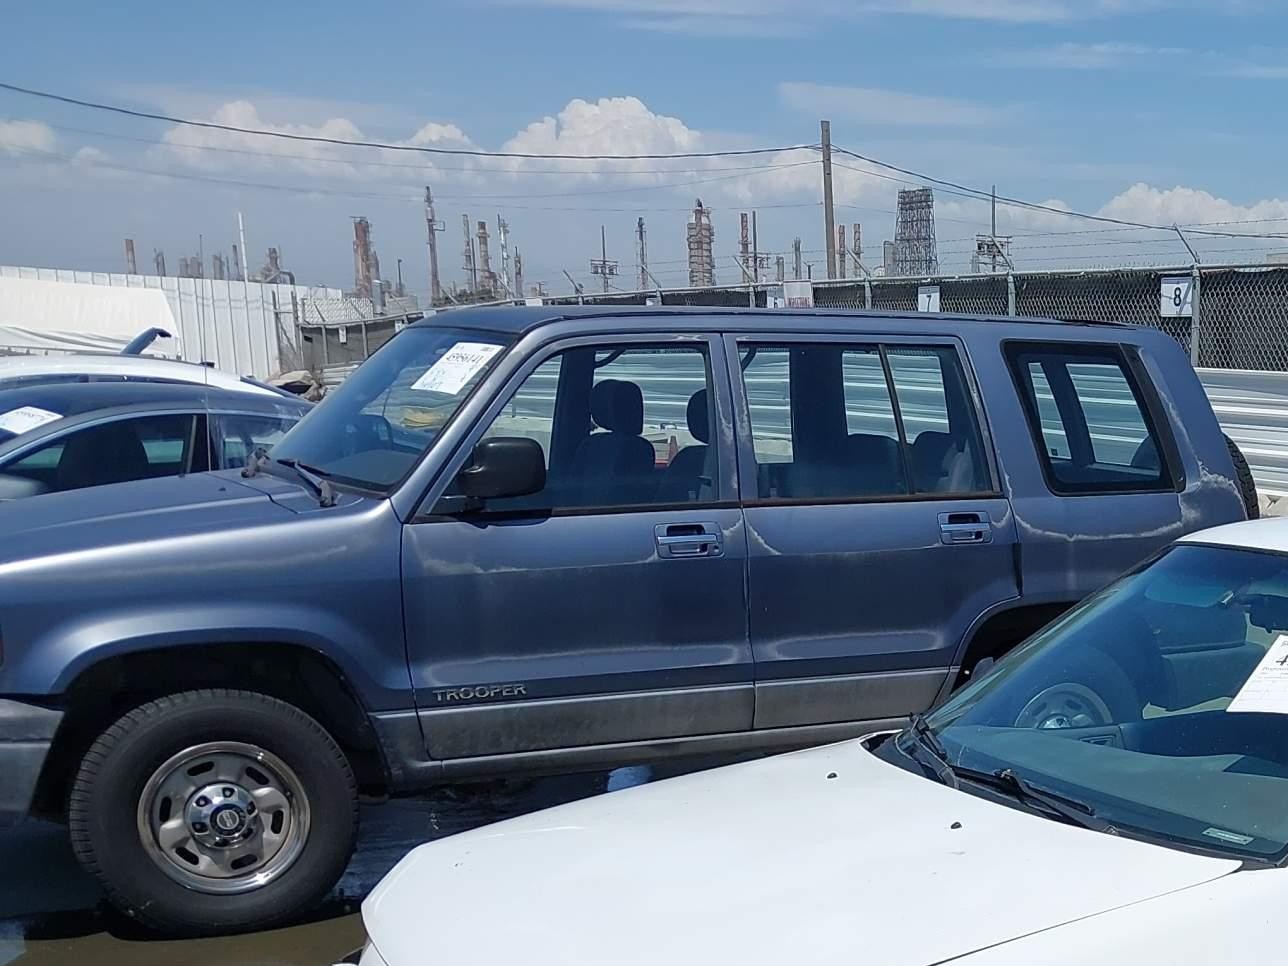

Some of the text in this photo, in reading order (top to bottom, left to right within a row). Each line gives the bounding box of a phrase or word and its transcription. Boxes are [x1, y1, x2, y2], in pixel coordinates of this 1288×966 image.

[926, 295, 932, 313] 7
[1173, 286, 1182, 307] 8
[432, 683, 527, 702] TROOPER
